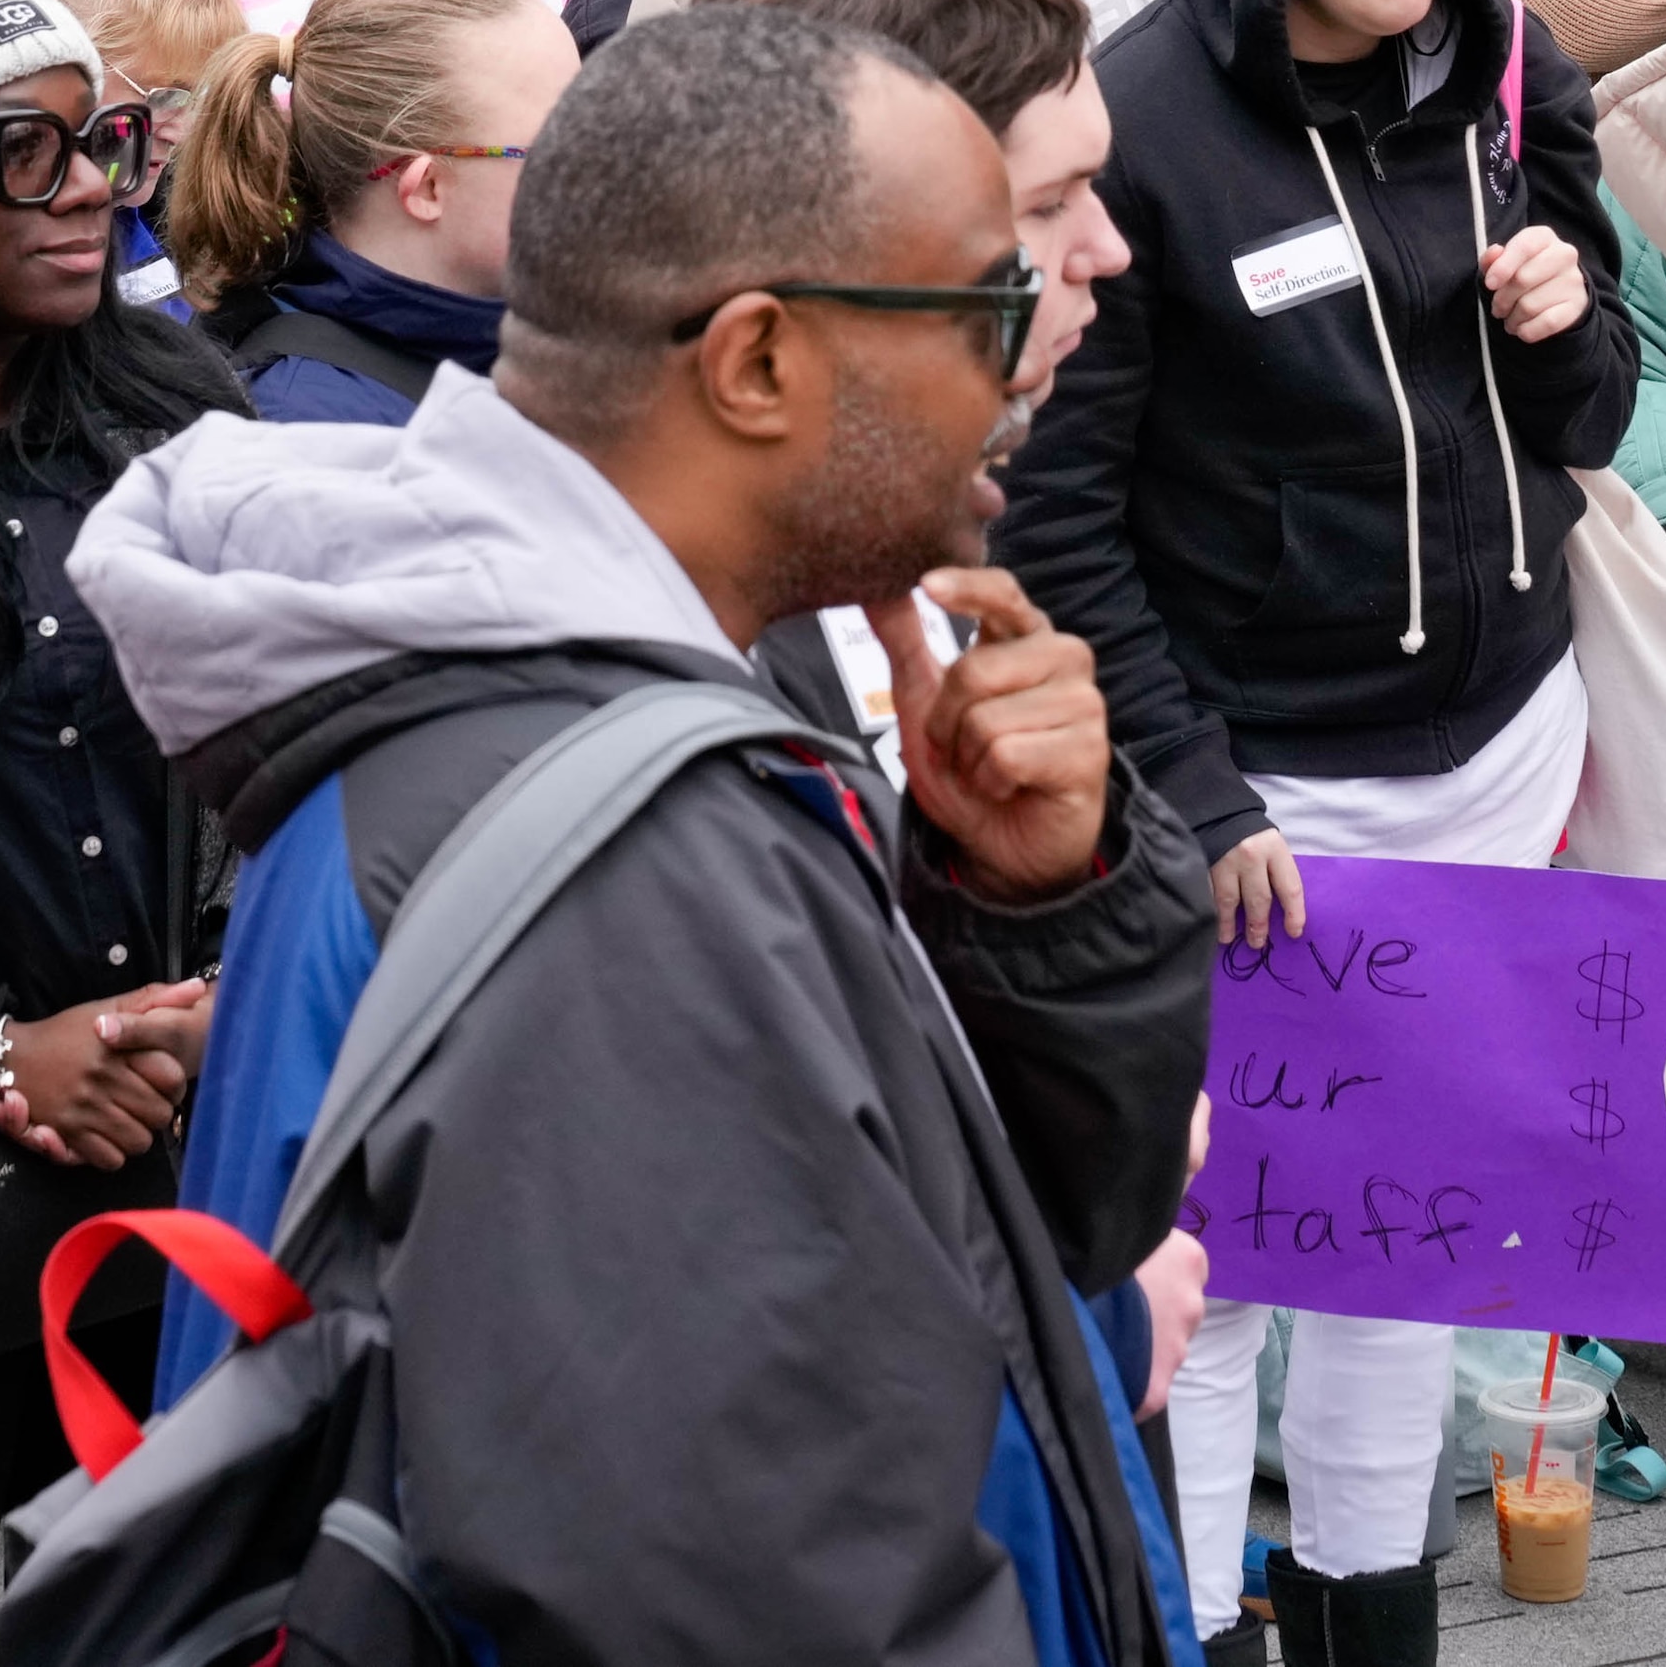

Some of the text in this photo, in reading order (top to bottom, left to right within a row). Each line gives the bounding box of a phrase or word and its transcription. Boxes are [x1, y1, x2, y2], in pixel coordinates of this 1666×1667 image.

[1249, 267, 1286, 287] Save
[1255, 264, 1351, 302] Self-Direction.
[1222, 929, 1427, 999] ave
[1230, 1052, 1383, 1112] ur
